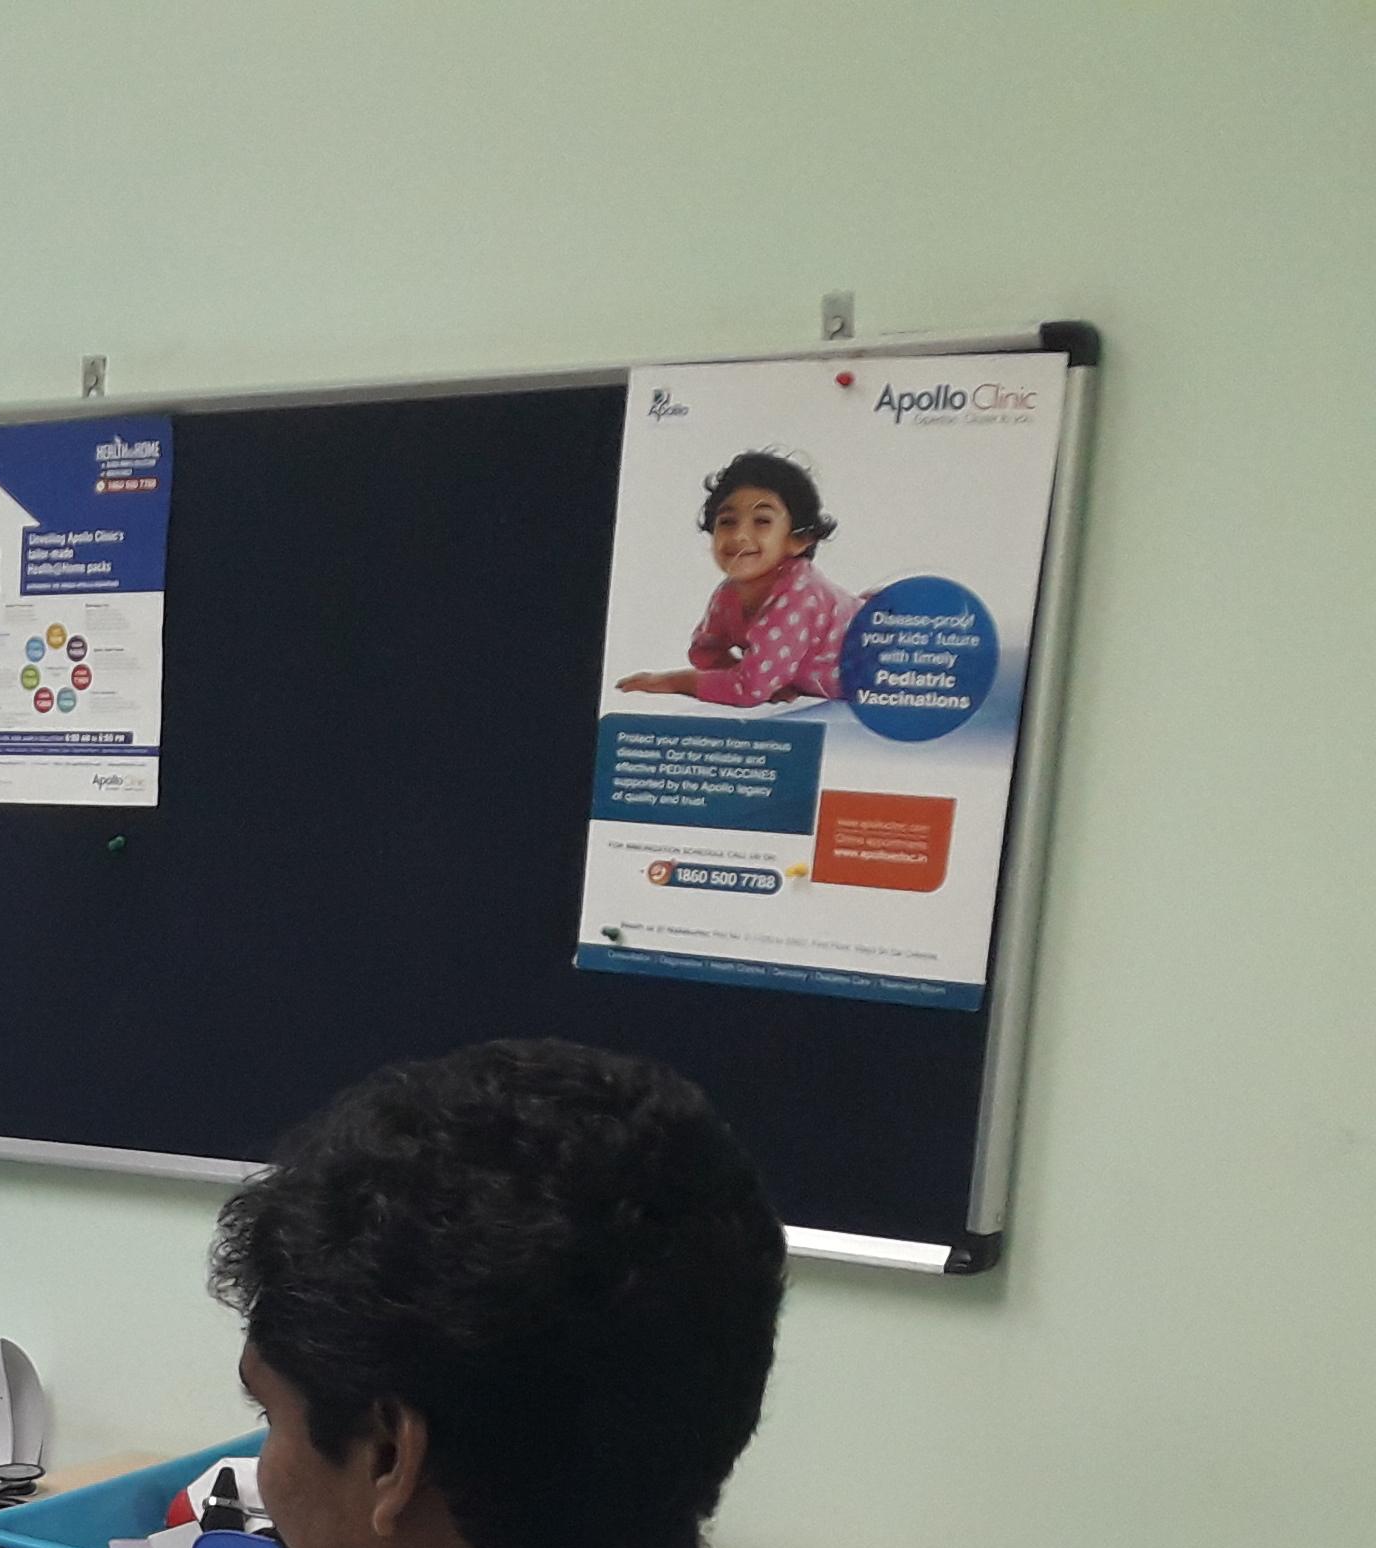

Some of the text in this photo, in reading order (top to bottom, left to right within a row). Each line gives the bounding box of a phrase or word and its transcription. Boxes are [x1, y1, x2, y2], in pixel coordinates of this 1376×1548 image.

[874, 383, 1038, 424] Apollo Clinic
[68, 531, 94, 545] Apollo
[873, 611, 976, 630] Disease-proof
[862, 631, 981, 647] your kids' future
[879, 650, 959, 668] with timely
[875, 670, 957, 688] Pediatric
[857, 689, 971, 709] Vaccinations
[617, 732, 655, 744] Protect
[656, 736, 680, 745] your
[681, 736, 724, 747] children
[726, 738, 751, 748] from
[666, 749, 685, 761] Opt
[687, 750, 702, 761] for
[745, 755, 766, 765] and
[659, 764, 717, 777] PEDIATRIC
[719, 768, 777, 781] VACCINES
[92, 774, 124, 791] Apollo
[667, 780, 680, 791] by
[682, 781, 698, 791] the
[700, 782, 735, 793] Apollo
[612, 790, 624, 800] of
[659, 794, 680, 804] and
[676, 867, 776, 889] 1860 500 7788
